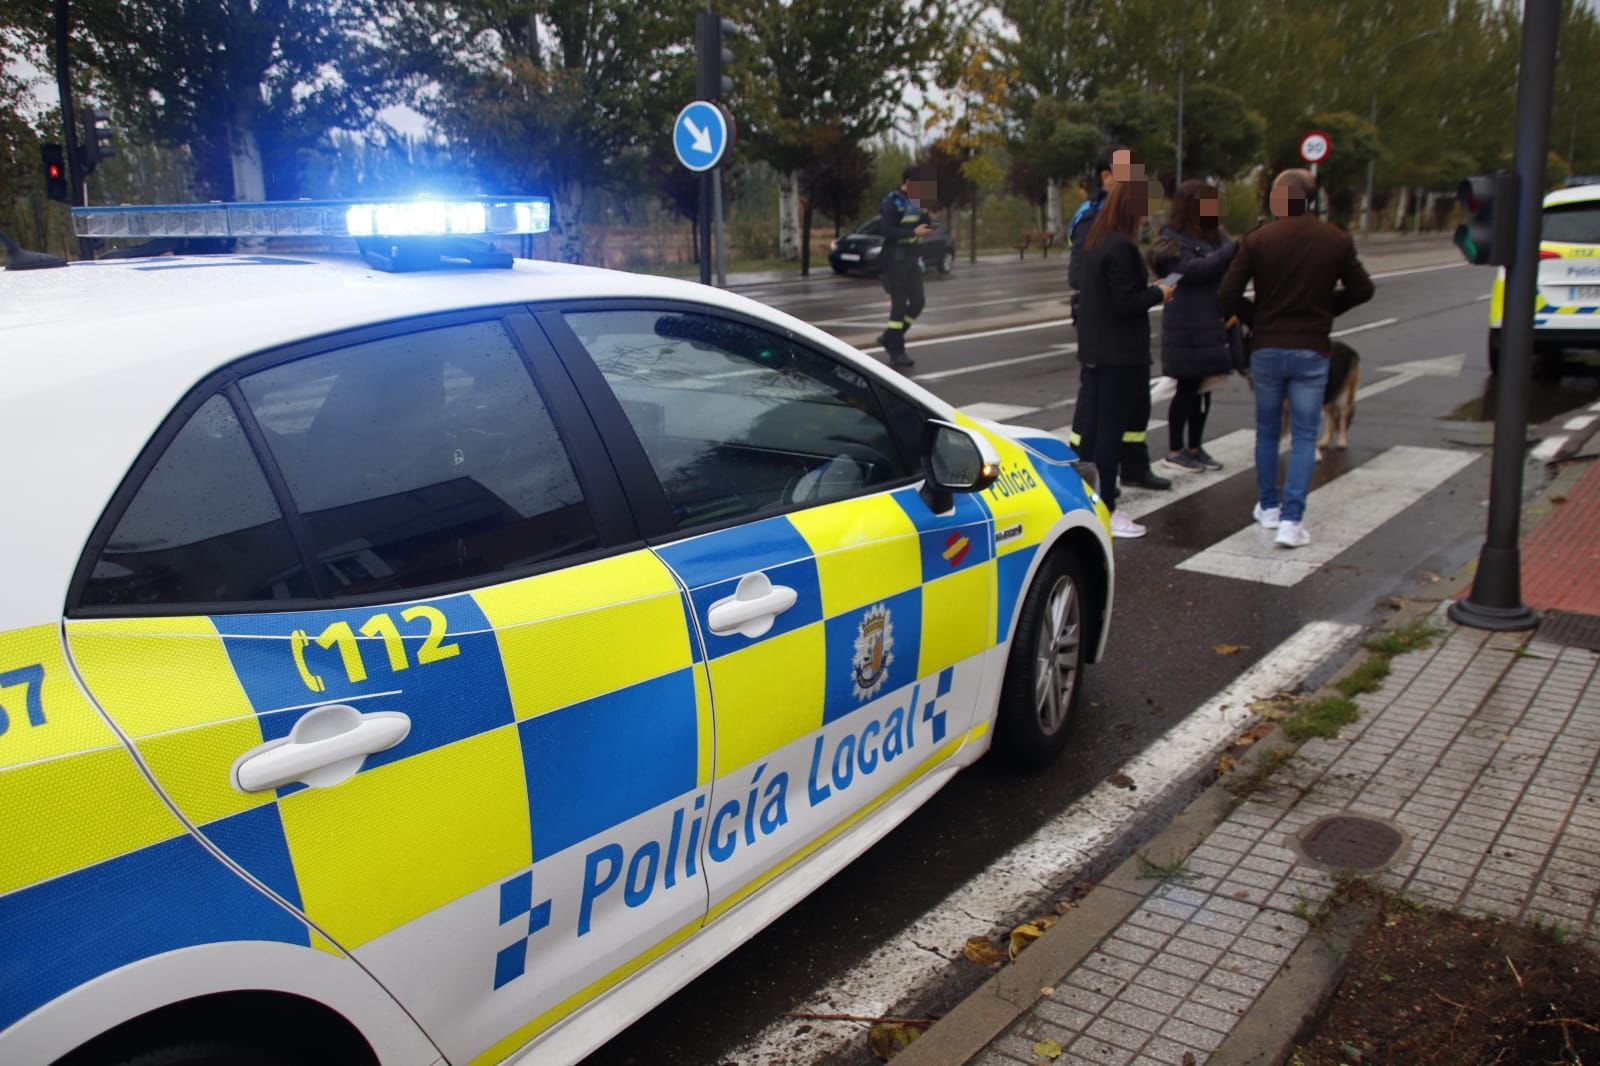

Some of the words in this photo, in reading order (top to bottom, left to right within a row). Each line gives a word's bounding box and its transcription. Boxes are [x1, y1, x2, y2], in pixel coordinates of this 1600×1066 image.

[315, 605, 461, 683] 112
[0, 663, 48, 737] 7
[577, 762, 789, 937] Policía
[808, 684, 921, 807] Local
